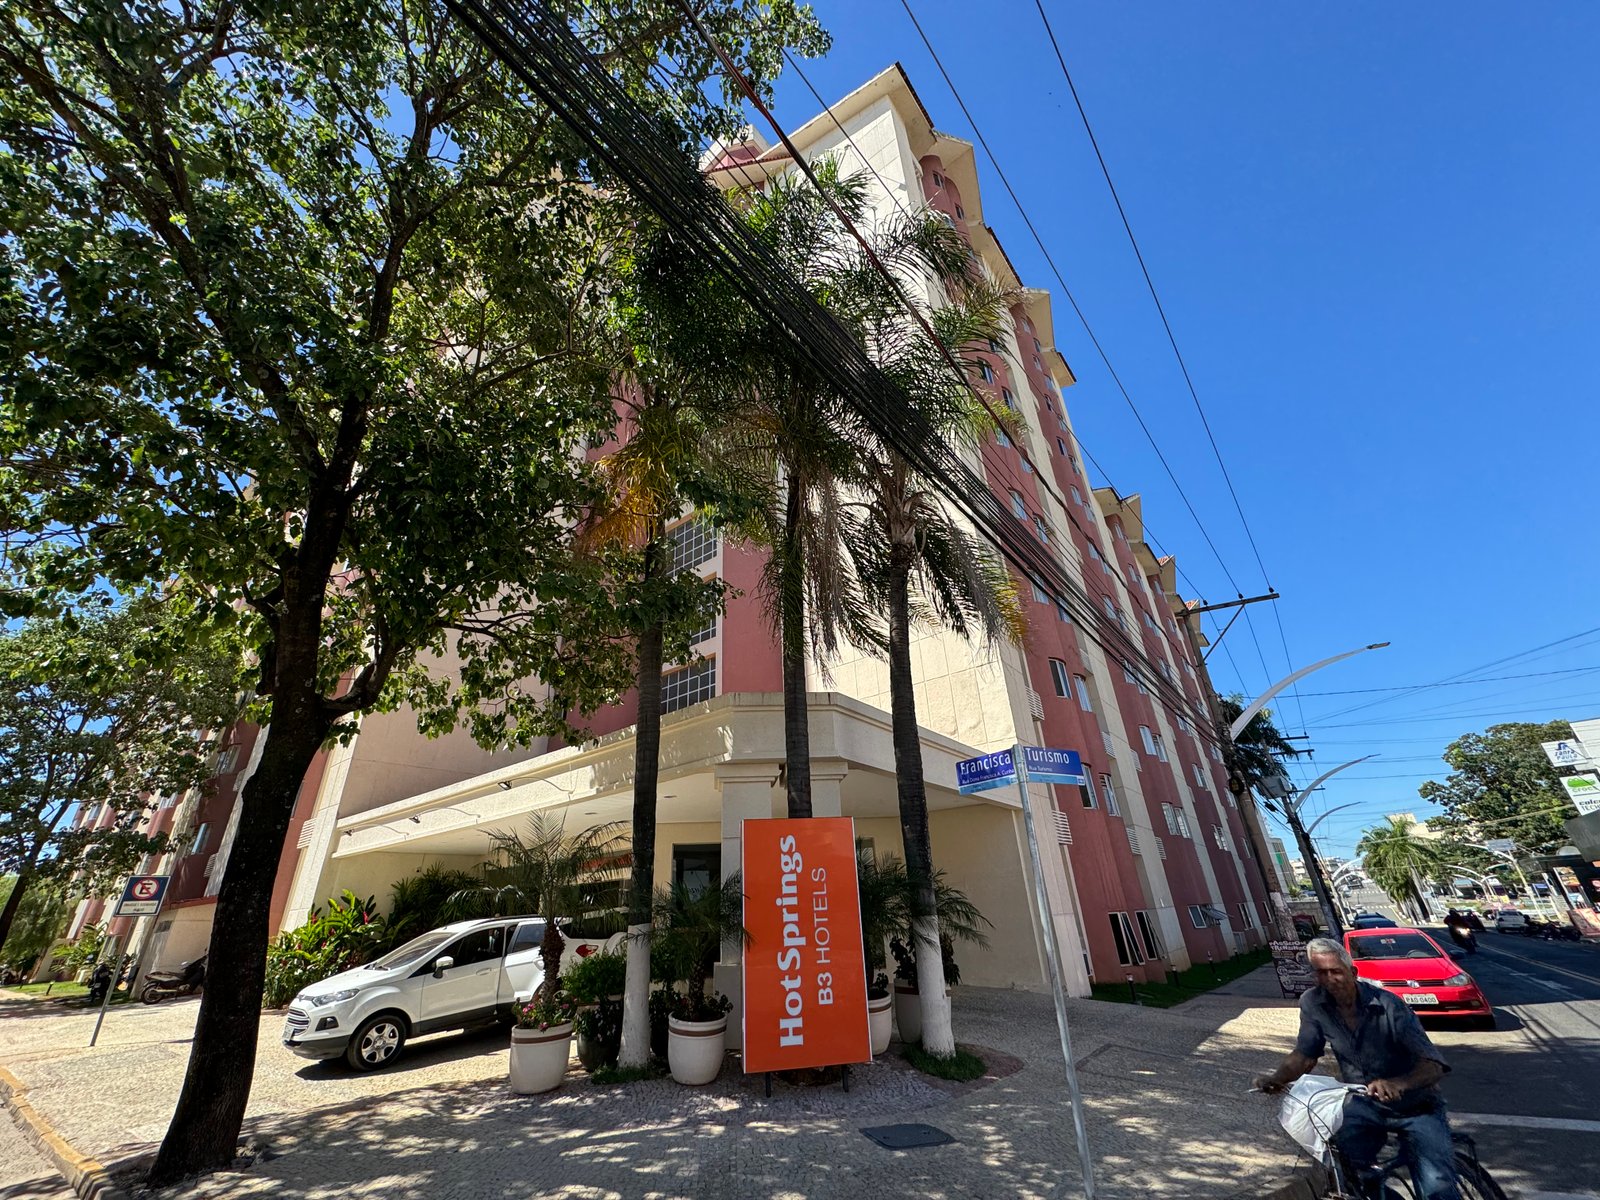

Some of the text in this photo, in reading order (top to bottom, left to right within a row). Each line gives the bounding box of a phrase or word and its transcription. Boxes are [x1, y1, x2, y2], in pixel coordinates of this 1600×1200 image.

[960, 753, 1011, 775] Francisca
[1024, 747, 1070, 764] Turismo
[775, 834, 806, 1047] HotSprings
[811, 867, 833, 1005] B3 HOTELS
